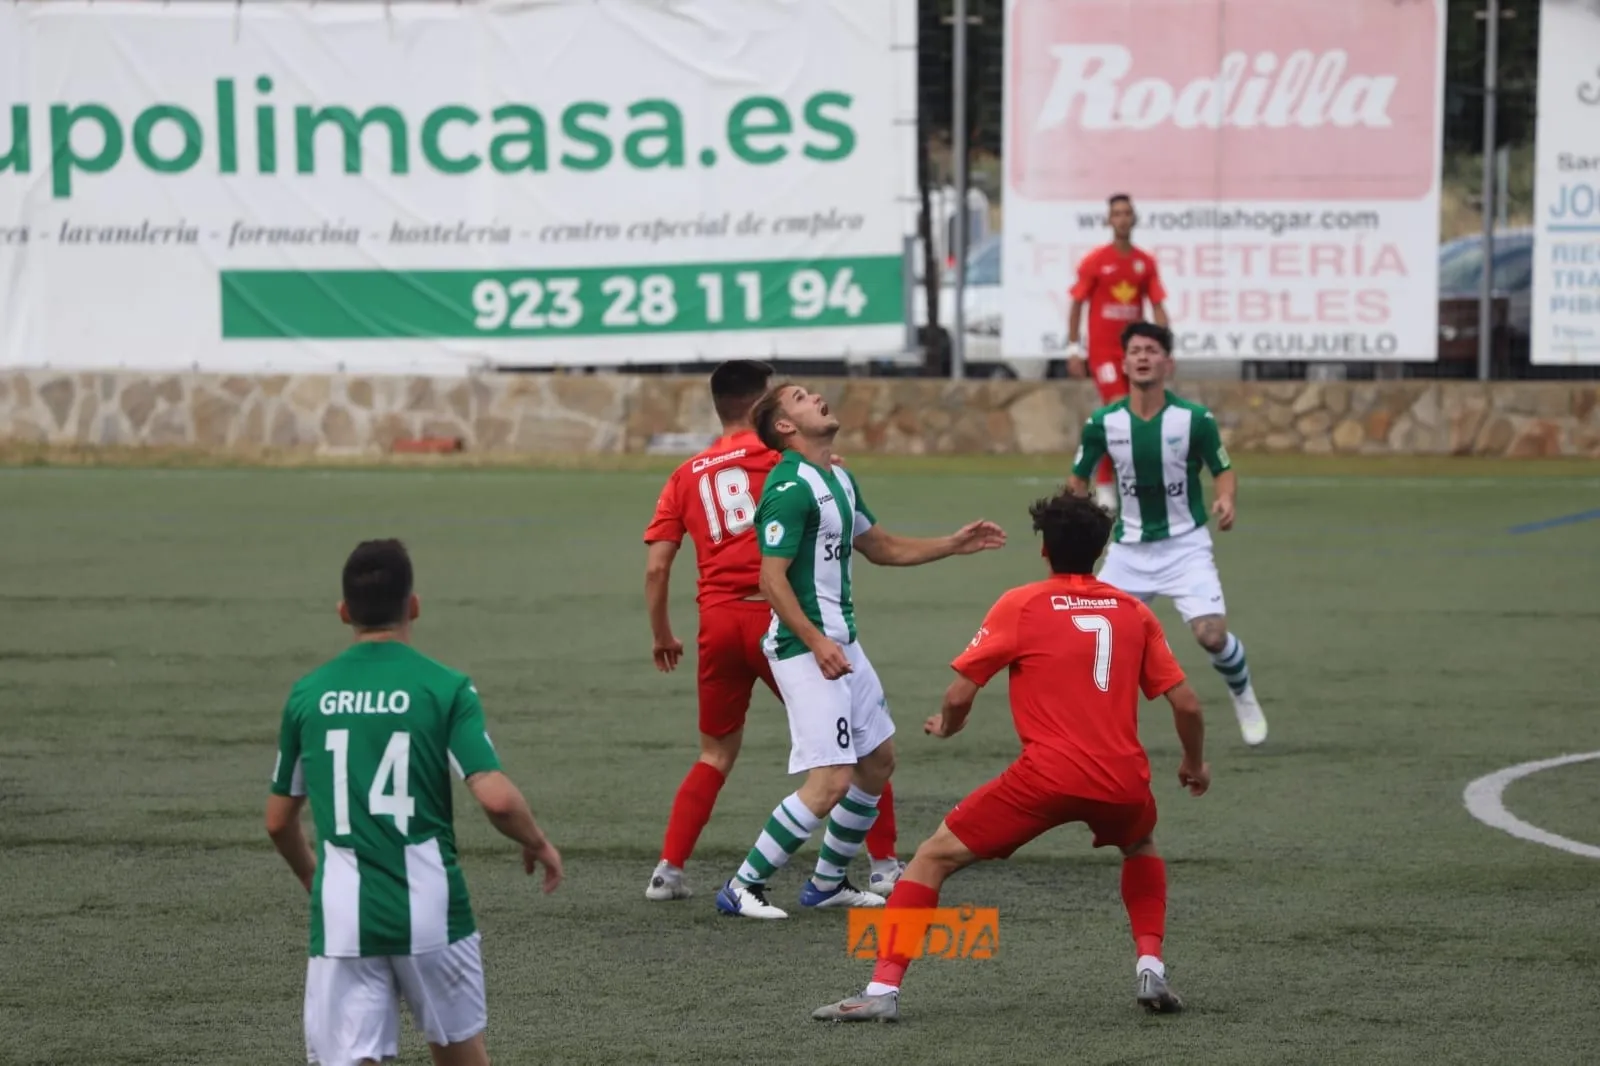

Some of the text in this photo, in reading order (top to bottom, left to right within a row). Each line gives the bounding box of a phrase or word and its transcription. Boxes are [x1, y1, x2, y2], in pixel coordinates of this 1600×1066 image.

[1036, 43, 1397, 131] Rodilla
[539, 219, 621, 242] centro
[626, 211, 729, 243] especial
[736, 211, 766, 236] de
[772, 207, 864, 237] empleo
[1077, 205, 1379, 233] ww.rodillahogar.com
[1032, 234, 1408, 276] FRETERÍA
[472, 268, 866, 330] 923 28 11 94
[1226, 334, 1244, 354] Y
[1252, 333, 1397, 355] GUIJUELO
[699, 466, 756, 544] 18
[1069, 596, 1118, 607] Limcasa
[1071, 614, 1112, 692] 7
[319, 690, 410, 715] GRILLO
[836, 717, 850, 749] 8
[324, 729, 415, 836] 14
